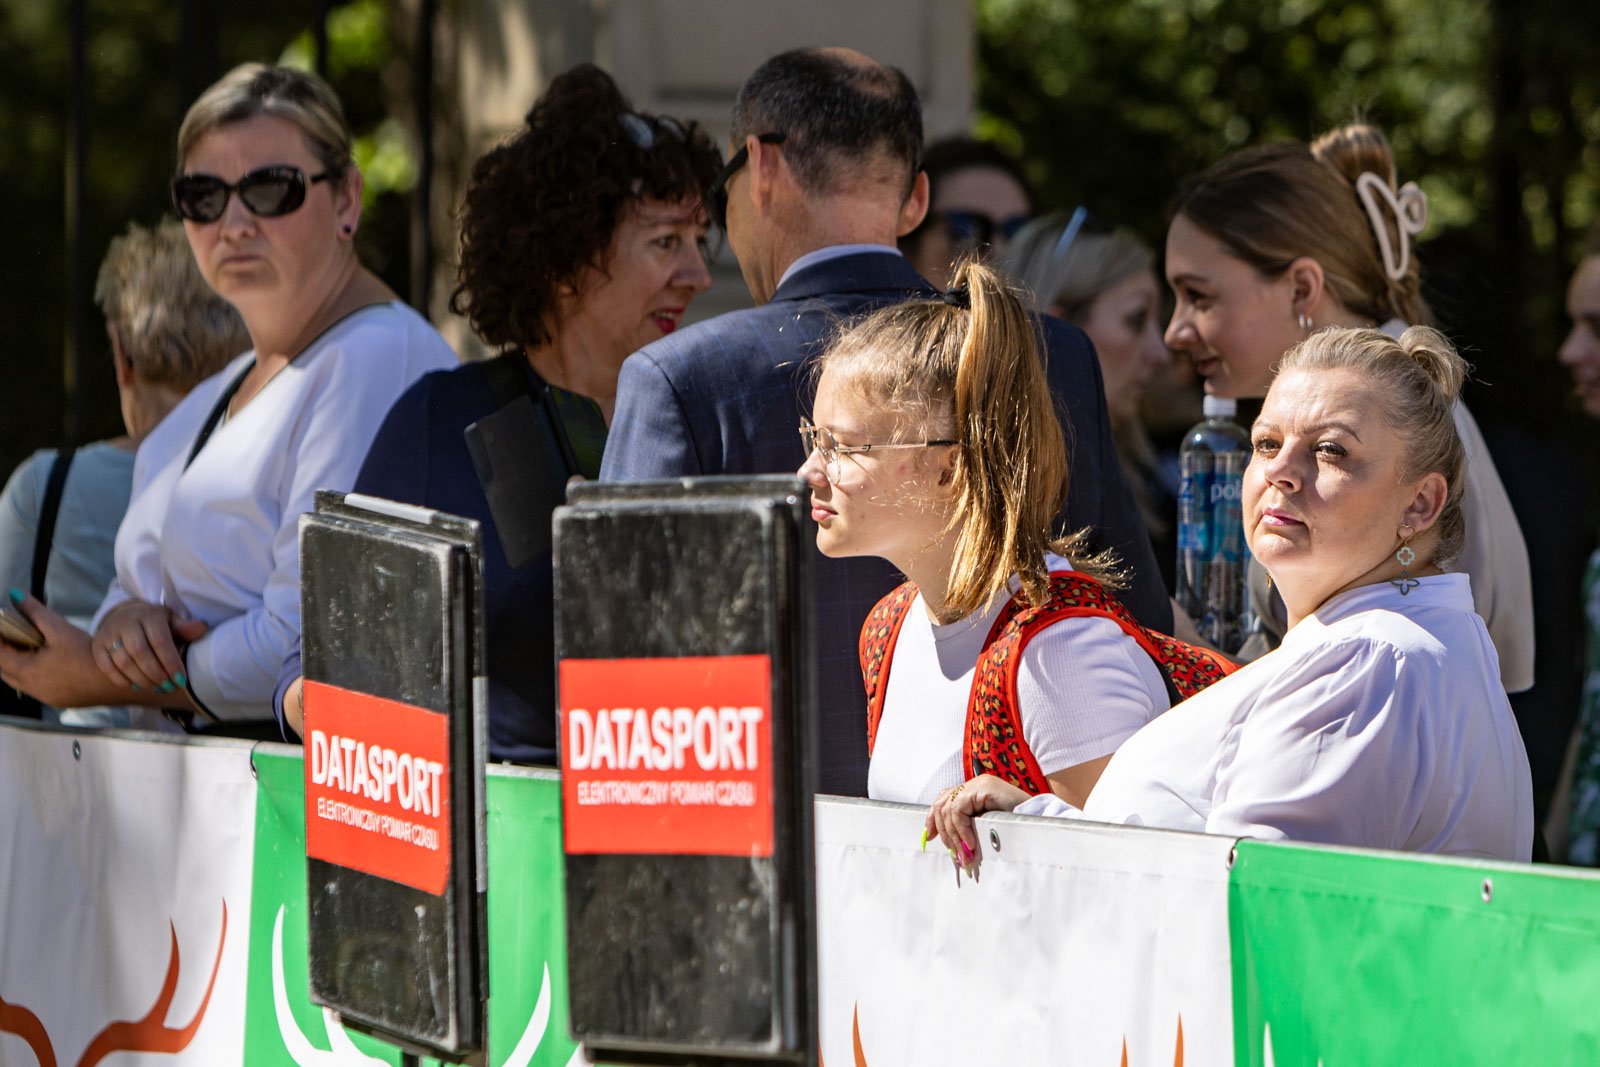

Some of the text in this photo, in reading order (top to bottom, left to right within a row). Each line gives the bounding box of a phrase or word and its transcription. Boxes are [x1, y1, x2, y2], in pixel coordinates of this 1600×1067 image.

[1211, 479, 1242, 504] pol
[569, 706, 764, 770] DATASPORT
[311, 730, 443, 818] DATASPORT
[577, 780, 757, 807] ELEKTRONICZNY POMIAR CZASU
[317, 796, 440, 851] ELEKTRONICZNY POMIAR CZASU
